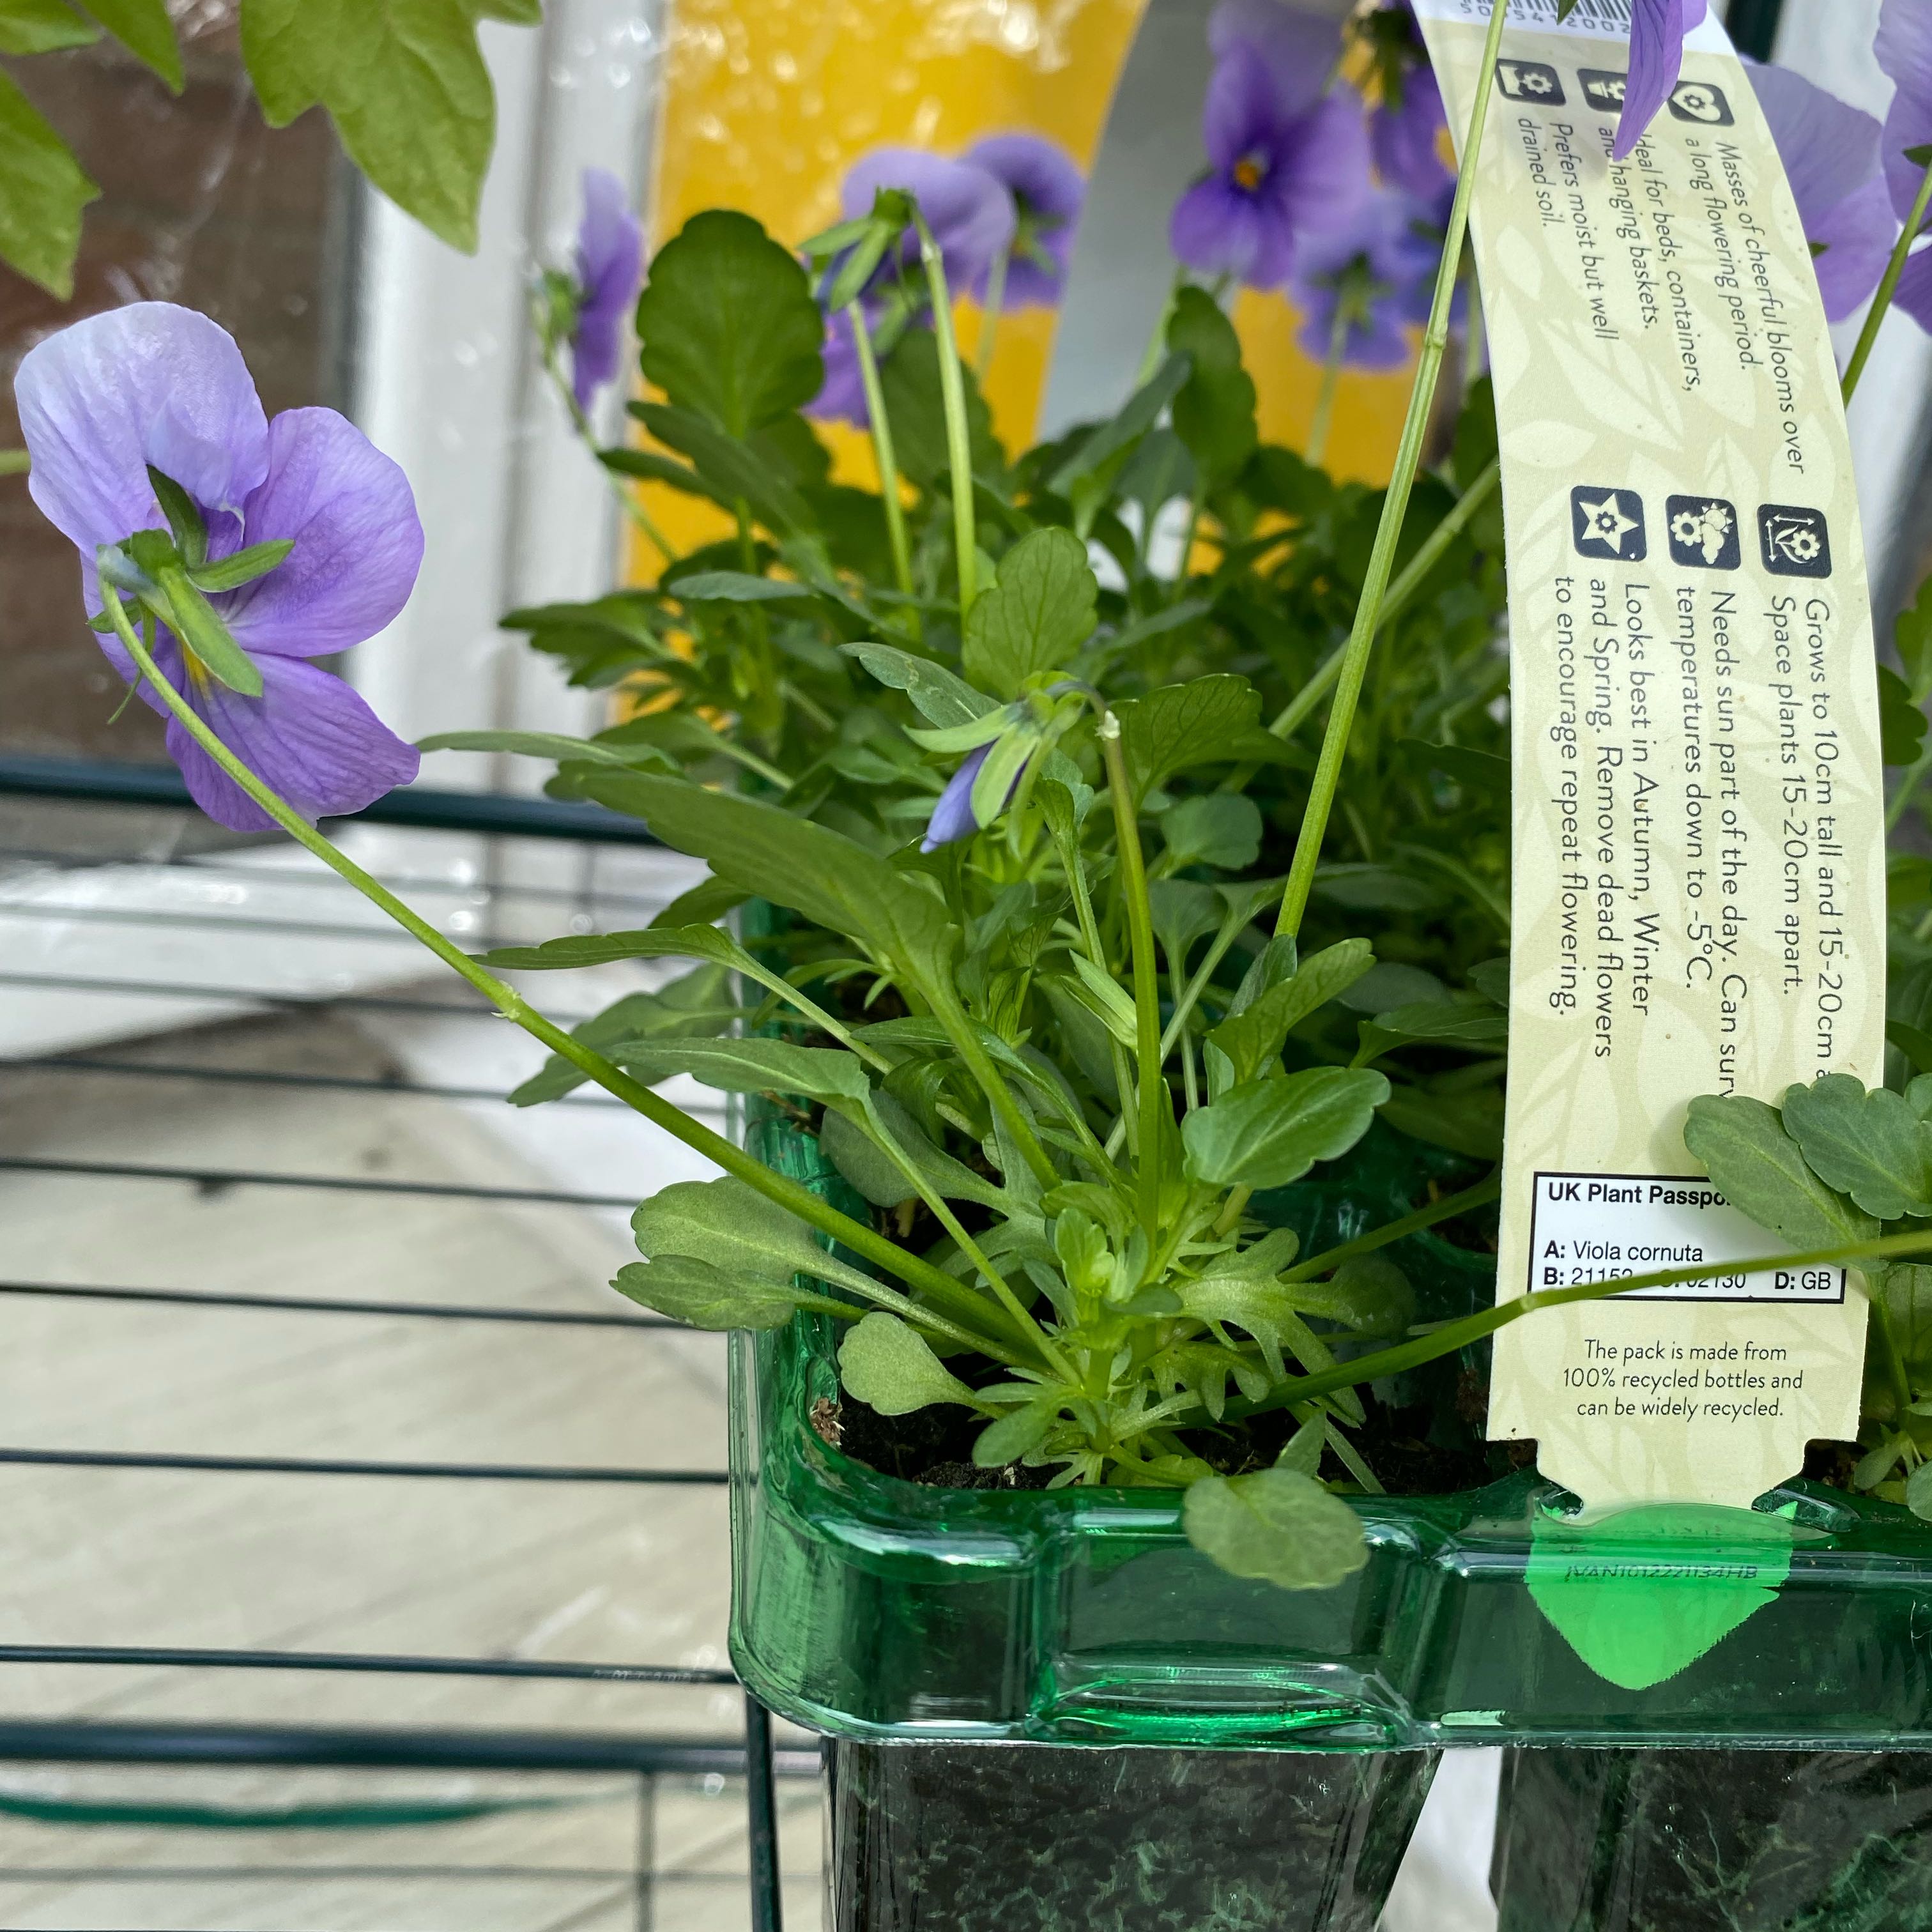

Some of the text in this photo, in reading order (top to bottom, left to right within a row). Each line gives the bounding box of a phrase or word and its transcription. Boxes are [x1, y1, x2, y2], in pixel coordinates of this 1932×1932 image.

[1518, 118, 1565, 226] drained soil.
[1644, 179, 1667, 207] for
[1689, 153, 1713, 191] long
[1550, 123, 1619, 339] Prefers moist but well
[1609, 164, 1643, 240] hanging
[1629, 247, 1660, 328] baskets.
[1653, 213, 1682, 262] beds,
[1704, 197, 1741, 289] flowering
[1666, 270, 1701, 391] containers,
[1716, 142, 1804, 474] Masses of cheerful blooms over
[1718, 295, 1763, 370] period.
[1711, 592, 1740, 676] Needs
[1805, 599, 1830, 682] Grows
[1717, 686, 1733, 732] sun
[1812, 693, 1830, 719] to
[1549, 576, 1588, 1015] to encourage repeat flowering.
[1670, 586, 1713, 988] temperatures down to -5°C.
[1709, 743, 1740, 800] part
[1763, 595, 1808, 995] Space plants 15-20cm apart.
[1814, 731, 1839, 804] 10cm
[1583, 579, 1624, 1057] and Spring. Remove dead flowers
[1625, 584, 1660, 1016] Looks best in Autumn, Winter
[1721, 809, 1747, 842] of
[1818, 815, 1843, 856] tall
[1722, 848, 1747, 894] the
[1818, 867, 1843, 916] and
[1712, 905, 1748, 962] day.
[1721, 974, 1747, 1032] Can
[1817, 927, 1843, 1058] 15-20cm
[1549, 1182, 1581, 1202] UK
[1588, 1183, 1642, 1203] Plant
[1544, 1240, 1703, 1262] A: Viola cornuta
[1544, 1266, 1564, 1285] B:
[1774, 1271, 1795, 1289] D:
[1802, 1271, 1831, 1290] GB
[1564, 1367, 1803, 1395] 100% recycled bottles and
[1584, 1339, 1786, 1367] The pack is made from
[1577, 1396, 1783, 1423] can be widely recycled.
